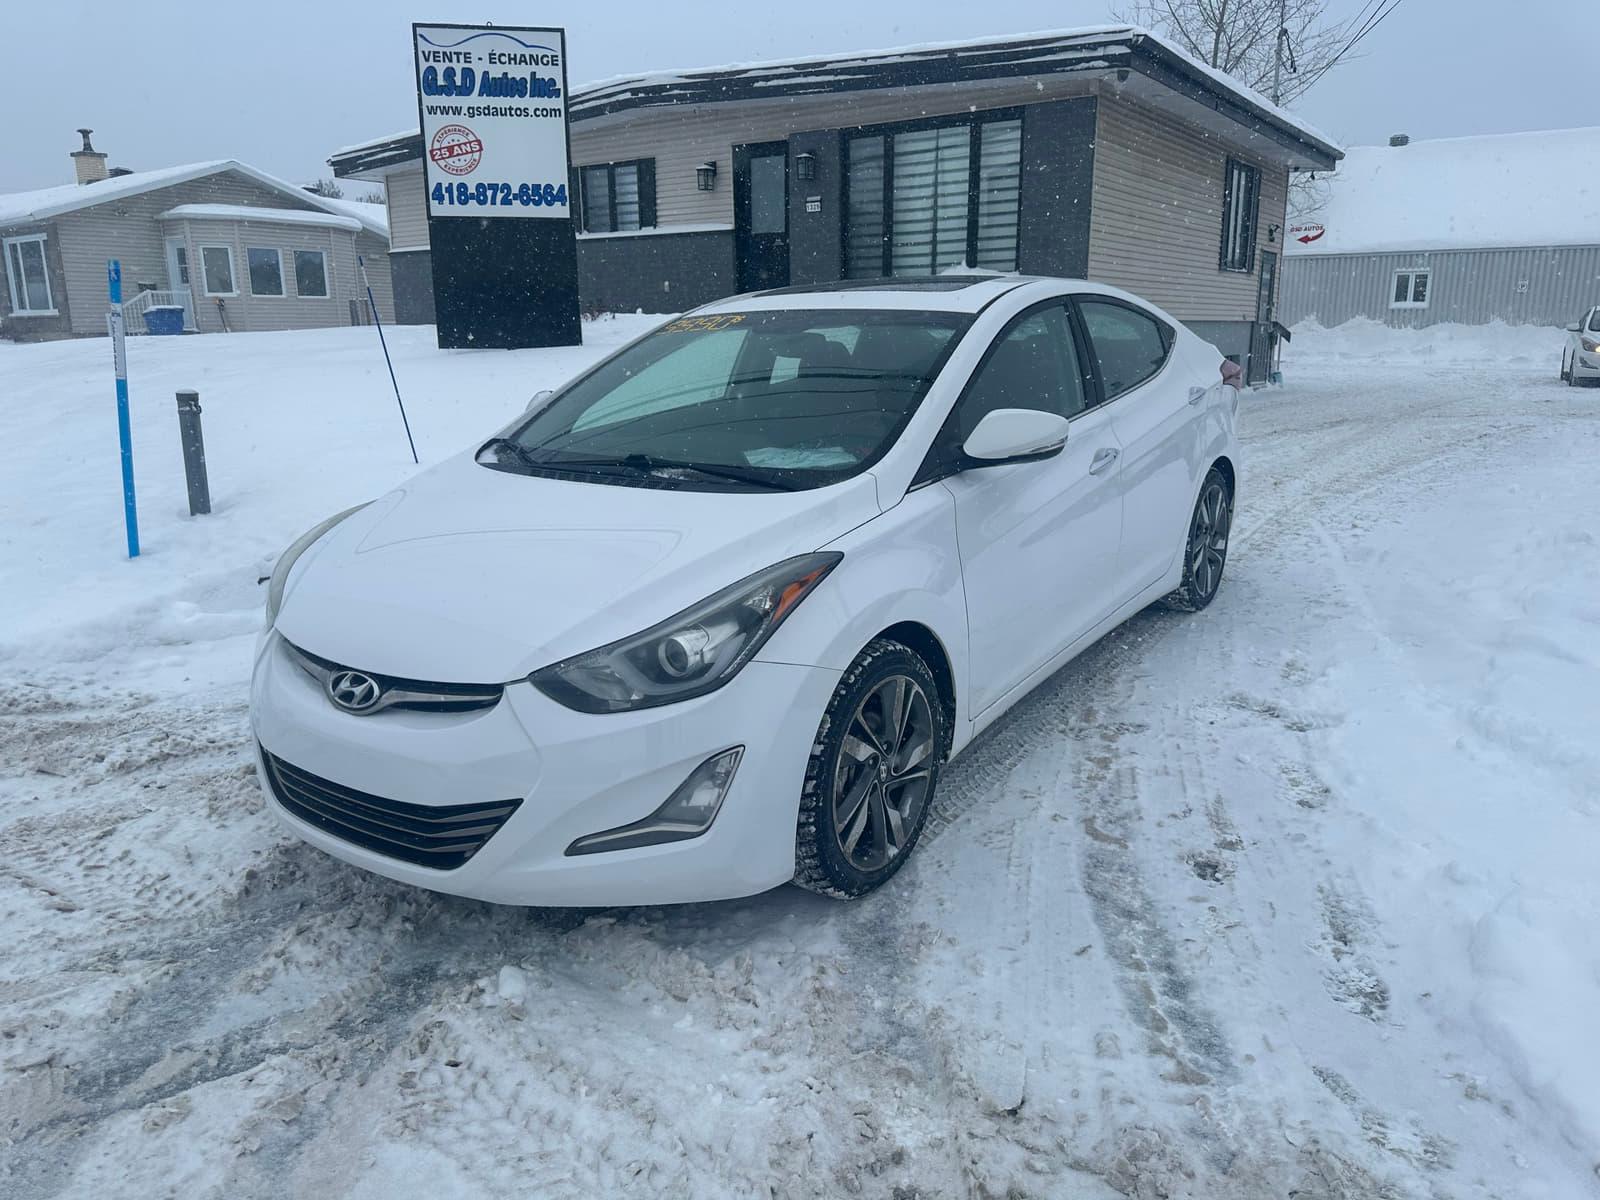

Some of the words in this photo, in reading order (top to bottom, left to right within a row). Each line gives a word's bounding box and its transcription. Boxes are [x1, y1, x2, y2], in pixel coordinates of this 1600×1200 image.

[422, 50, 472, 63] VENTE
[488, 49, 559, 66] ÉCHANGE
[478, 70, 528, 98] Autos
[529, 71, 561, 98] Inc.
[426, 104, 562, 118] www.gsdautos.com
[433, 149, 450, 160] 25
[453, 141, 480, 155] ANS
[431, 182, 568, 207] 418-872-6564
